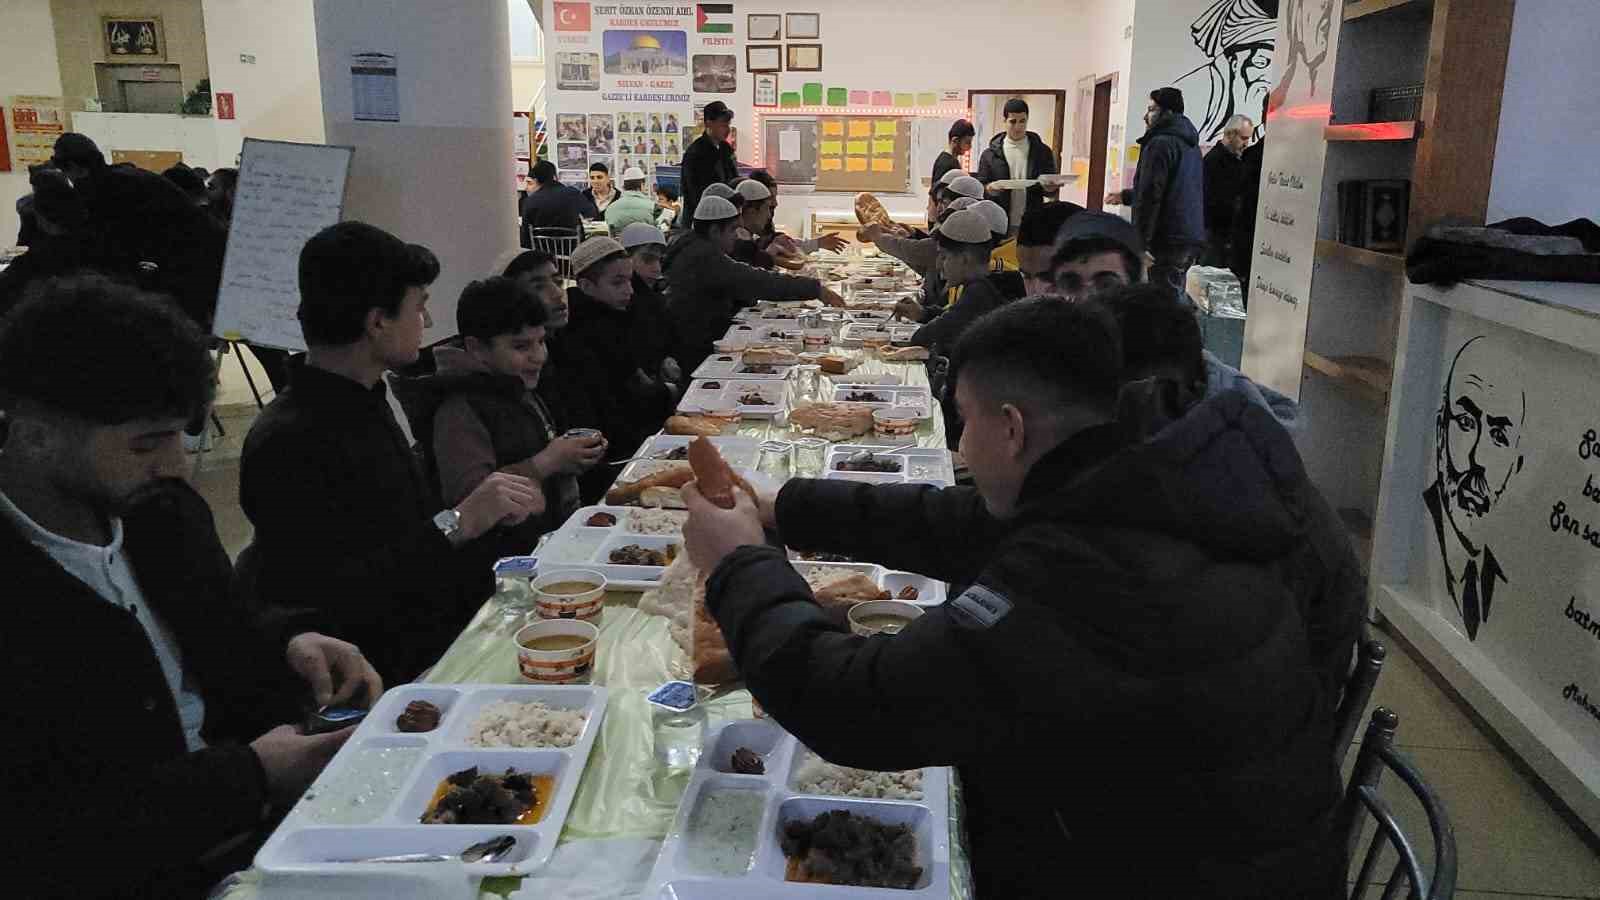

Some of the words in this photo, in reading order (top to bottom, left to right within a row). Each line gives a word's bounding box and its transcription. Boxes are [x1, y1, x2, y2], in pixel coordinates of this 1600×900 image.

[1579, 428, 1600, 460] Sa
[1582, 473, 1600, 503] ba
[1582, 523, 1600, 549] sa
[1565, 596, 1600, 641] batm
